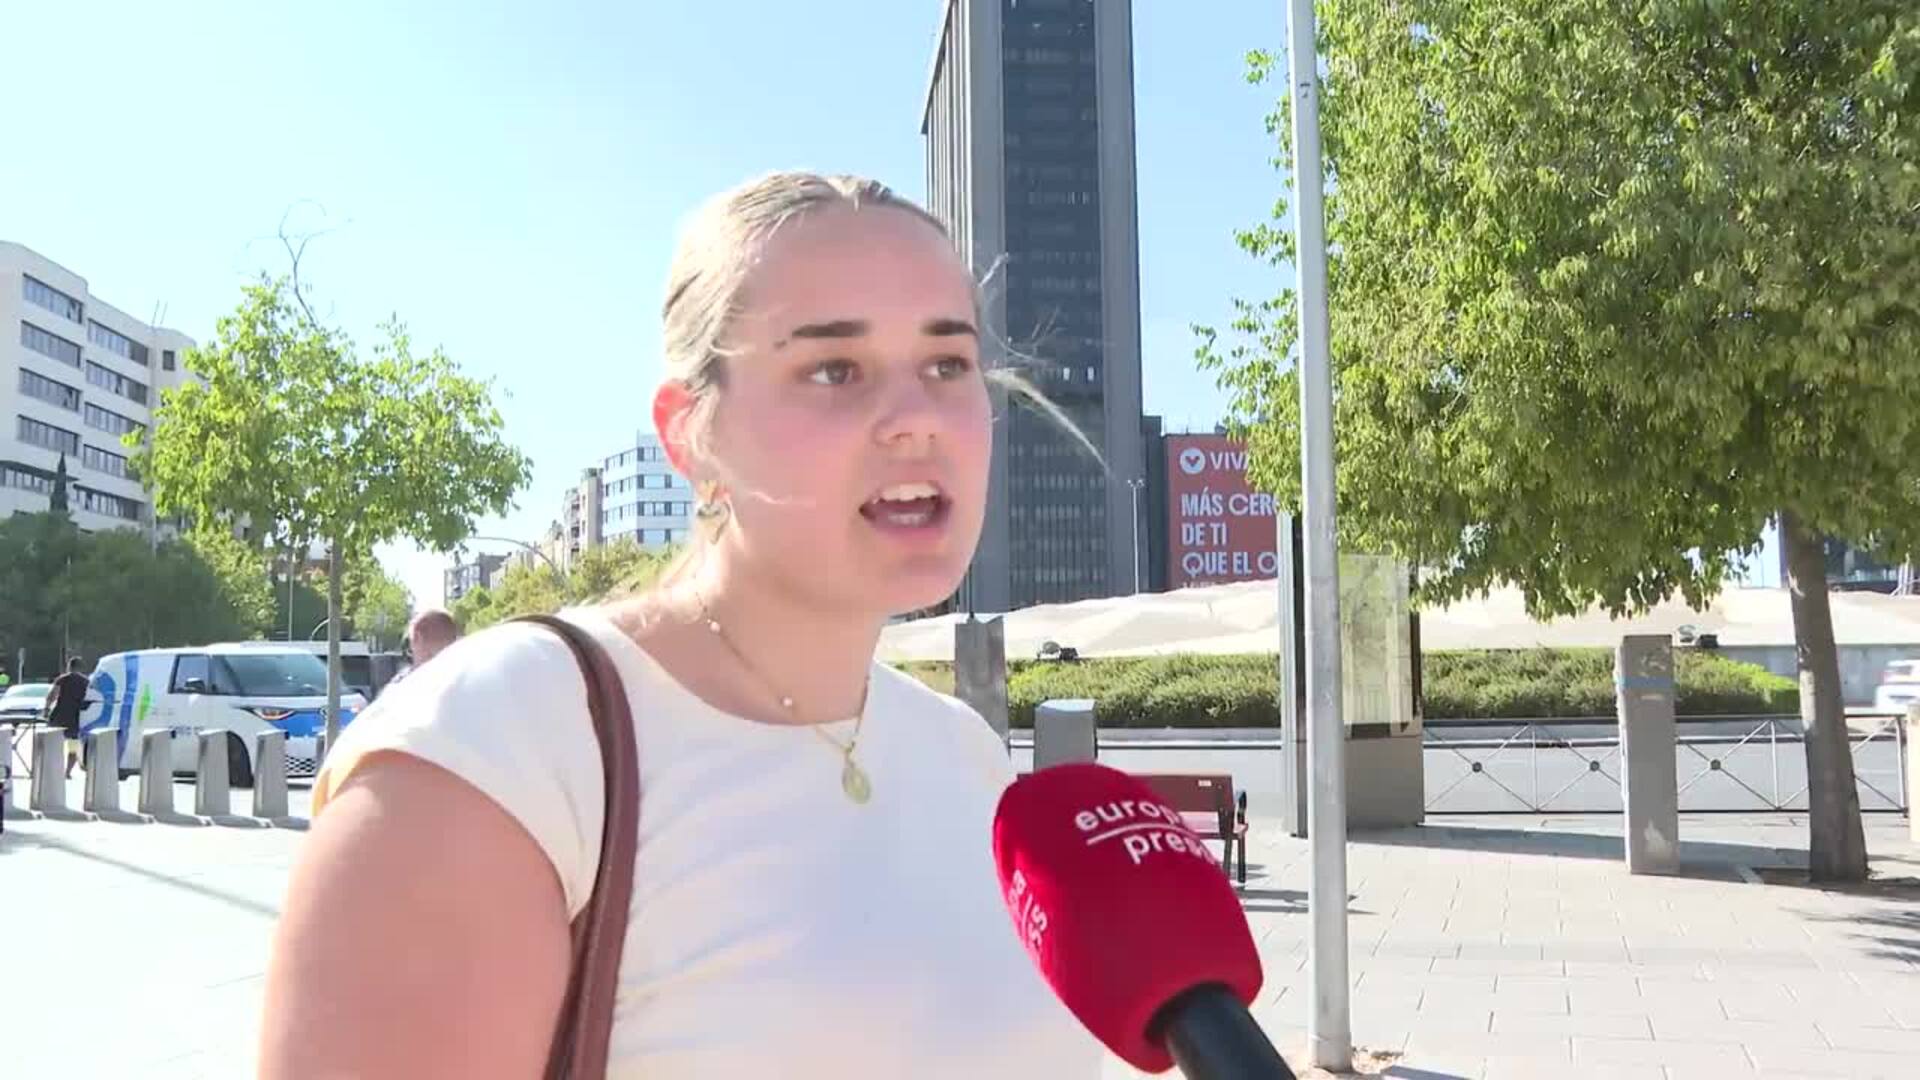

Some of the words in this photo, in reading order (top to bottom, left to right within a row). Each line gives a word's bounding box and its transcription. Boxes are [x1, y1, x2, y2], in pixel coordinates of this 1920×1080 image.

[1181, 487, 1223, 517] MÁS
[1182, 523, 1205, 545] DE
[1209, 523, 1227, 545] TI
[1182, 552, 1227, 577] QUE
[1232, 552, 1252, 575] EL
[1258, 552, 1278, 574] O
[1075, 800, 1181, 831] europ
